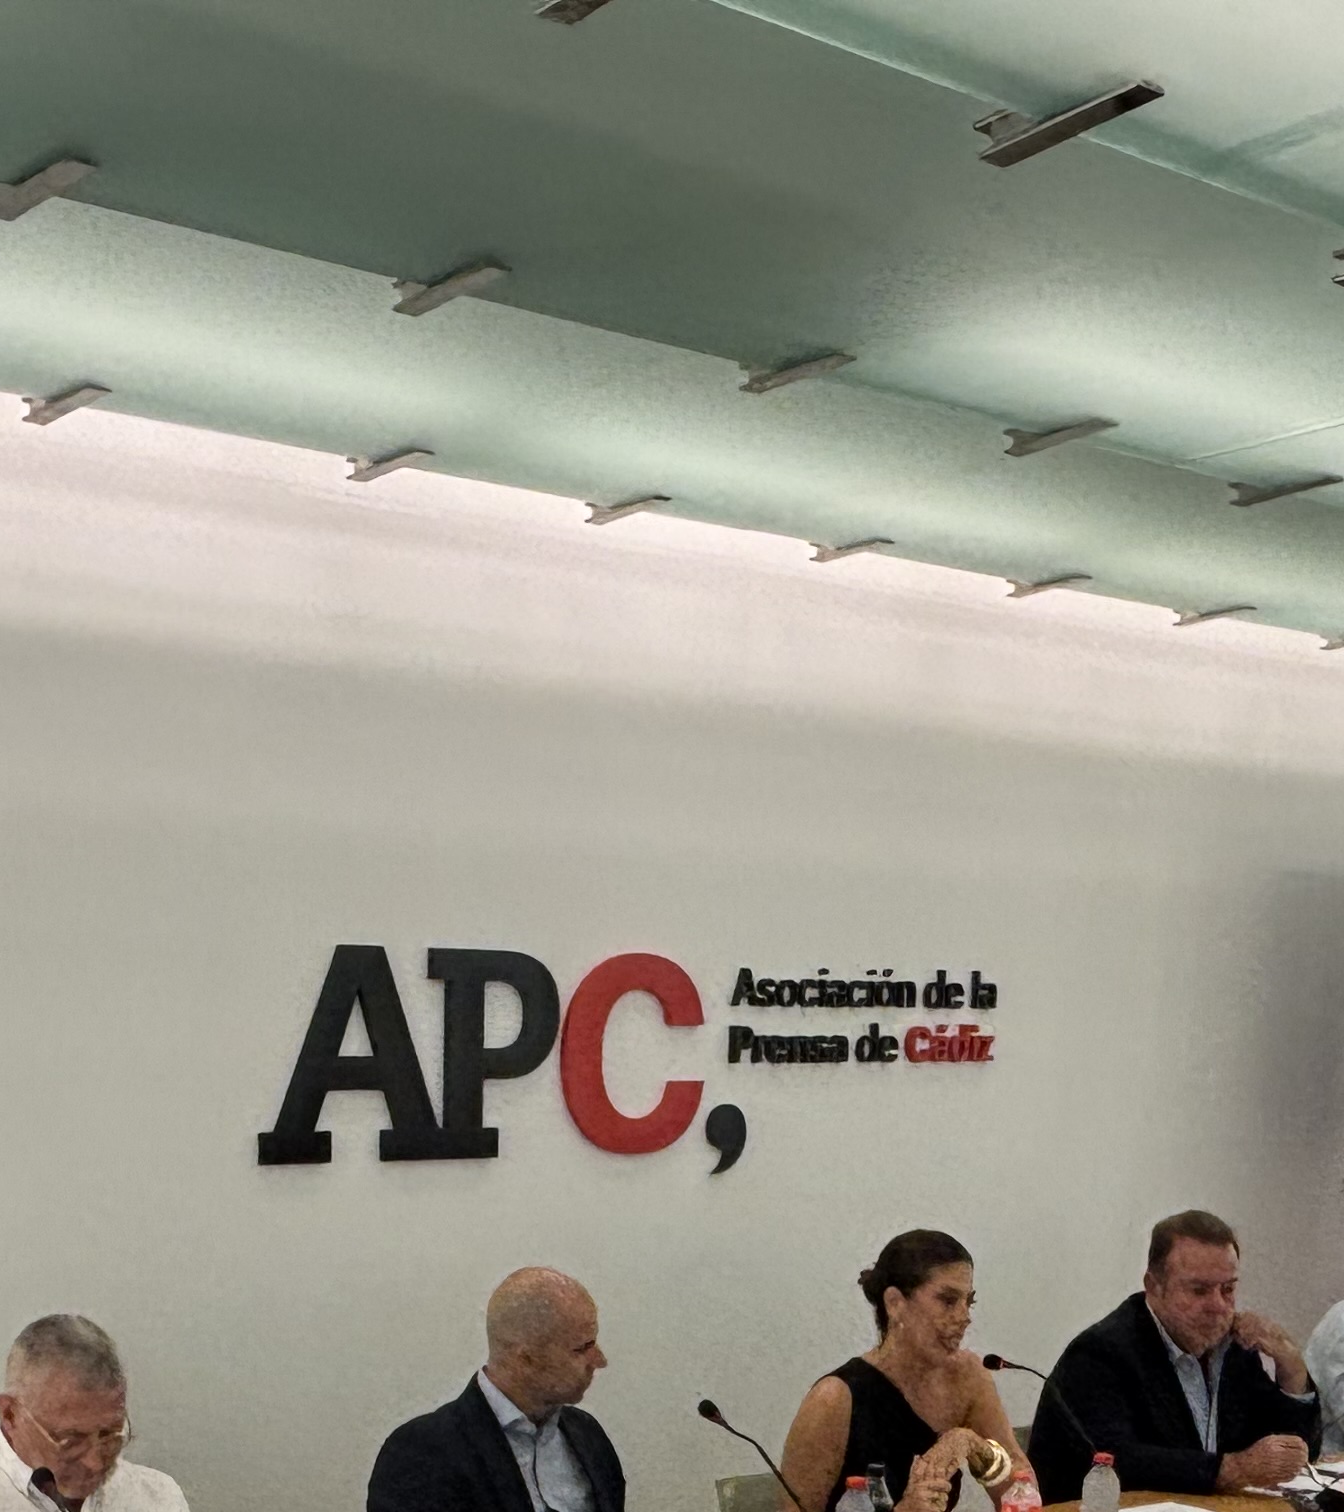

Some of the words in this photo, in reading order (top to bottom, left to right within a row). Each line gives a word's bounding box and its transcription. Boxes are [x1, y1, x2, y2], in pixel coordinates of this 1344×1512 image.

[730, 967, 916, 1008] Asociación
[923, 969, 965, 1009] de
[970, 970, 998, 1009] la
[728, 1025, 849, 1064] Prensa
[855, 1022, 899, 1063] de
[904, 1023, 995, 1063] Cádiz
